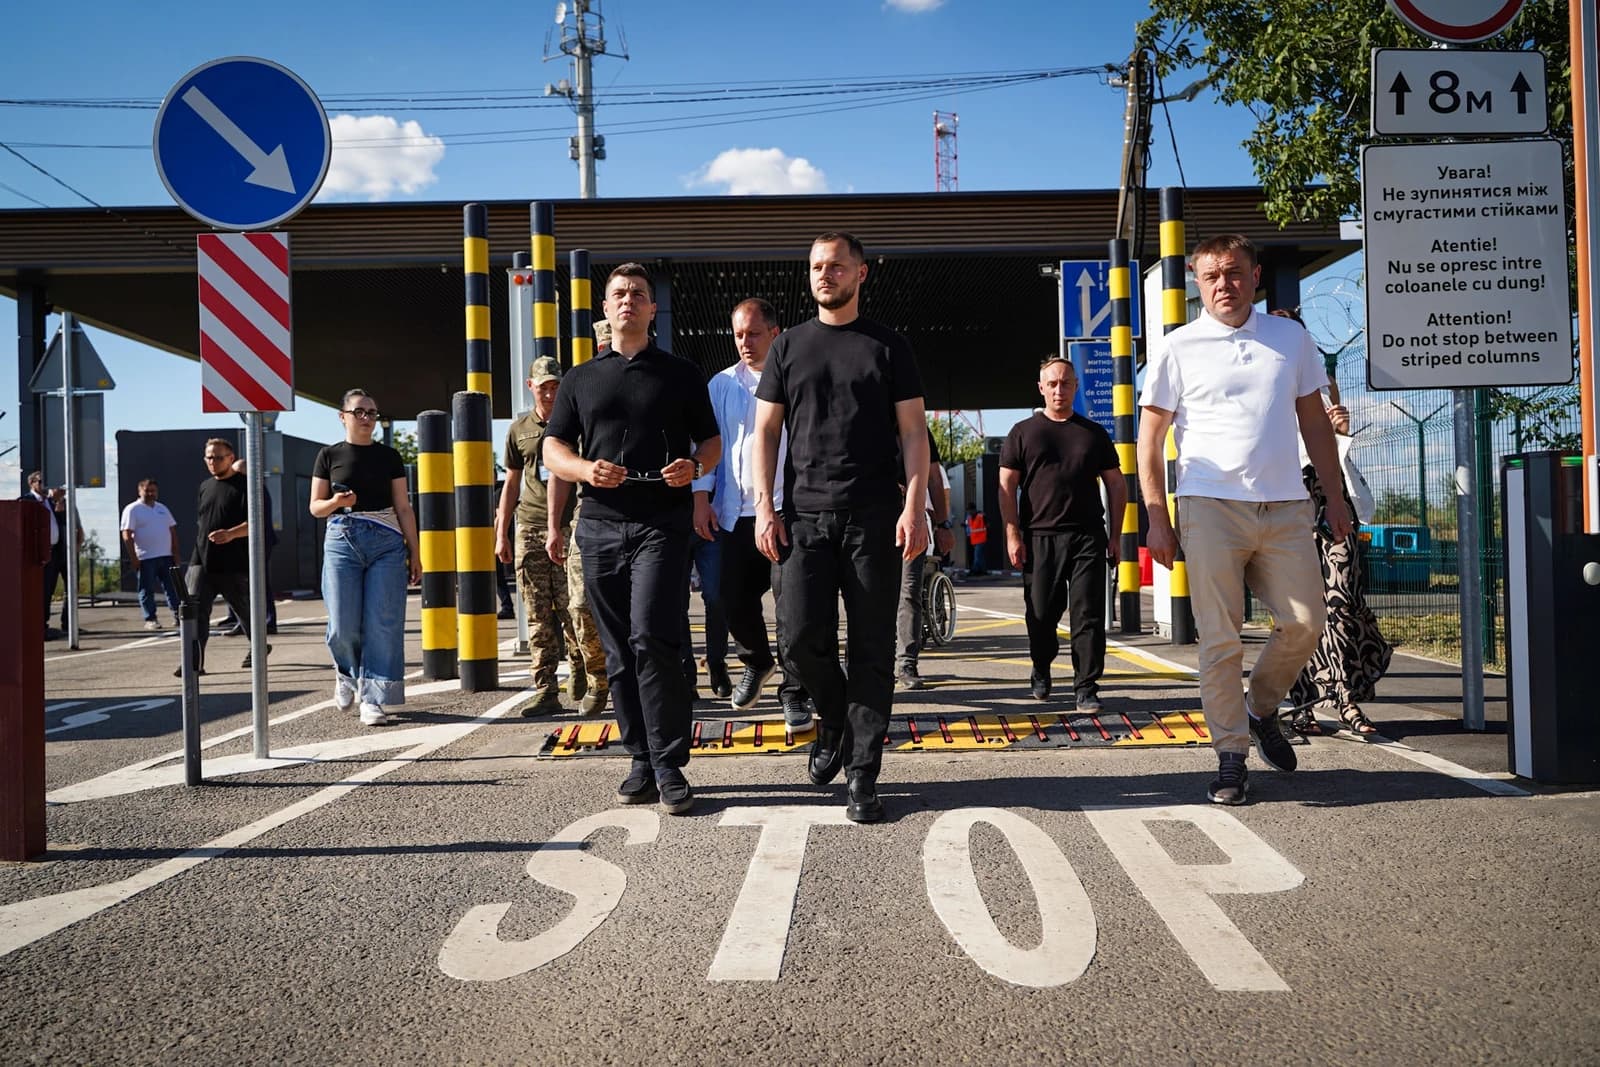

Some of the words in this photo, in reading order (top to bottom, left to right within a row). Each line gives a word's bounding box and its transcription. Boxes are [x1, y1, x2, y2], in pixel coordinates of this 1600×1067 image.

[1437, 164, 1492, 180] Увага!
[1383, 187, 1406, 202] Не
[1410, 186, 1513, 202] зупинятися
[1517, 182, 1549, 197] між
[1373, 207, 1477, 222] смугастими
[1481, 202, 1559, 218] стійками
[1431, 237, 1497, 253] Atentie!
[1388, 260, 1412, 275] Nu
[1416, 262, 1435, 274] se
[1440, 259, 1498, 276] opresc
[1502, 256, 1543, 271] intre
[1385, 278, 1468, 295] coloanele
[1472, 279, 1491, 291] cu
[1497, 274, 1545, 293] dung!
[1427, 310, 1512, 327] Attention!
[1383, 334, 1405, 348] Do
[1410, 333, 1438, 347] not
[1442, 332, 1480, 350] stop
[1484, 330, 1558, 345] between
[1401, 351, 1463, 369] striped
[1467, 349, 1541, 365] columns
[437, 804, 1306, 992] STOP
